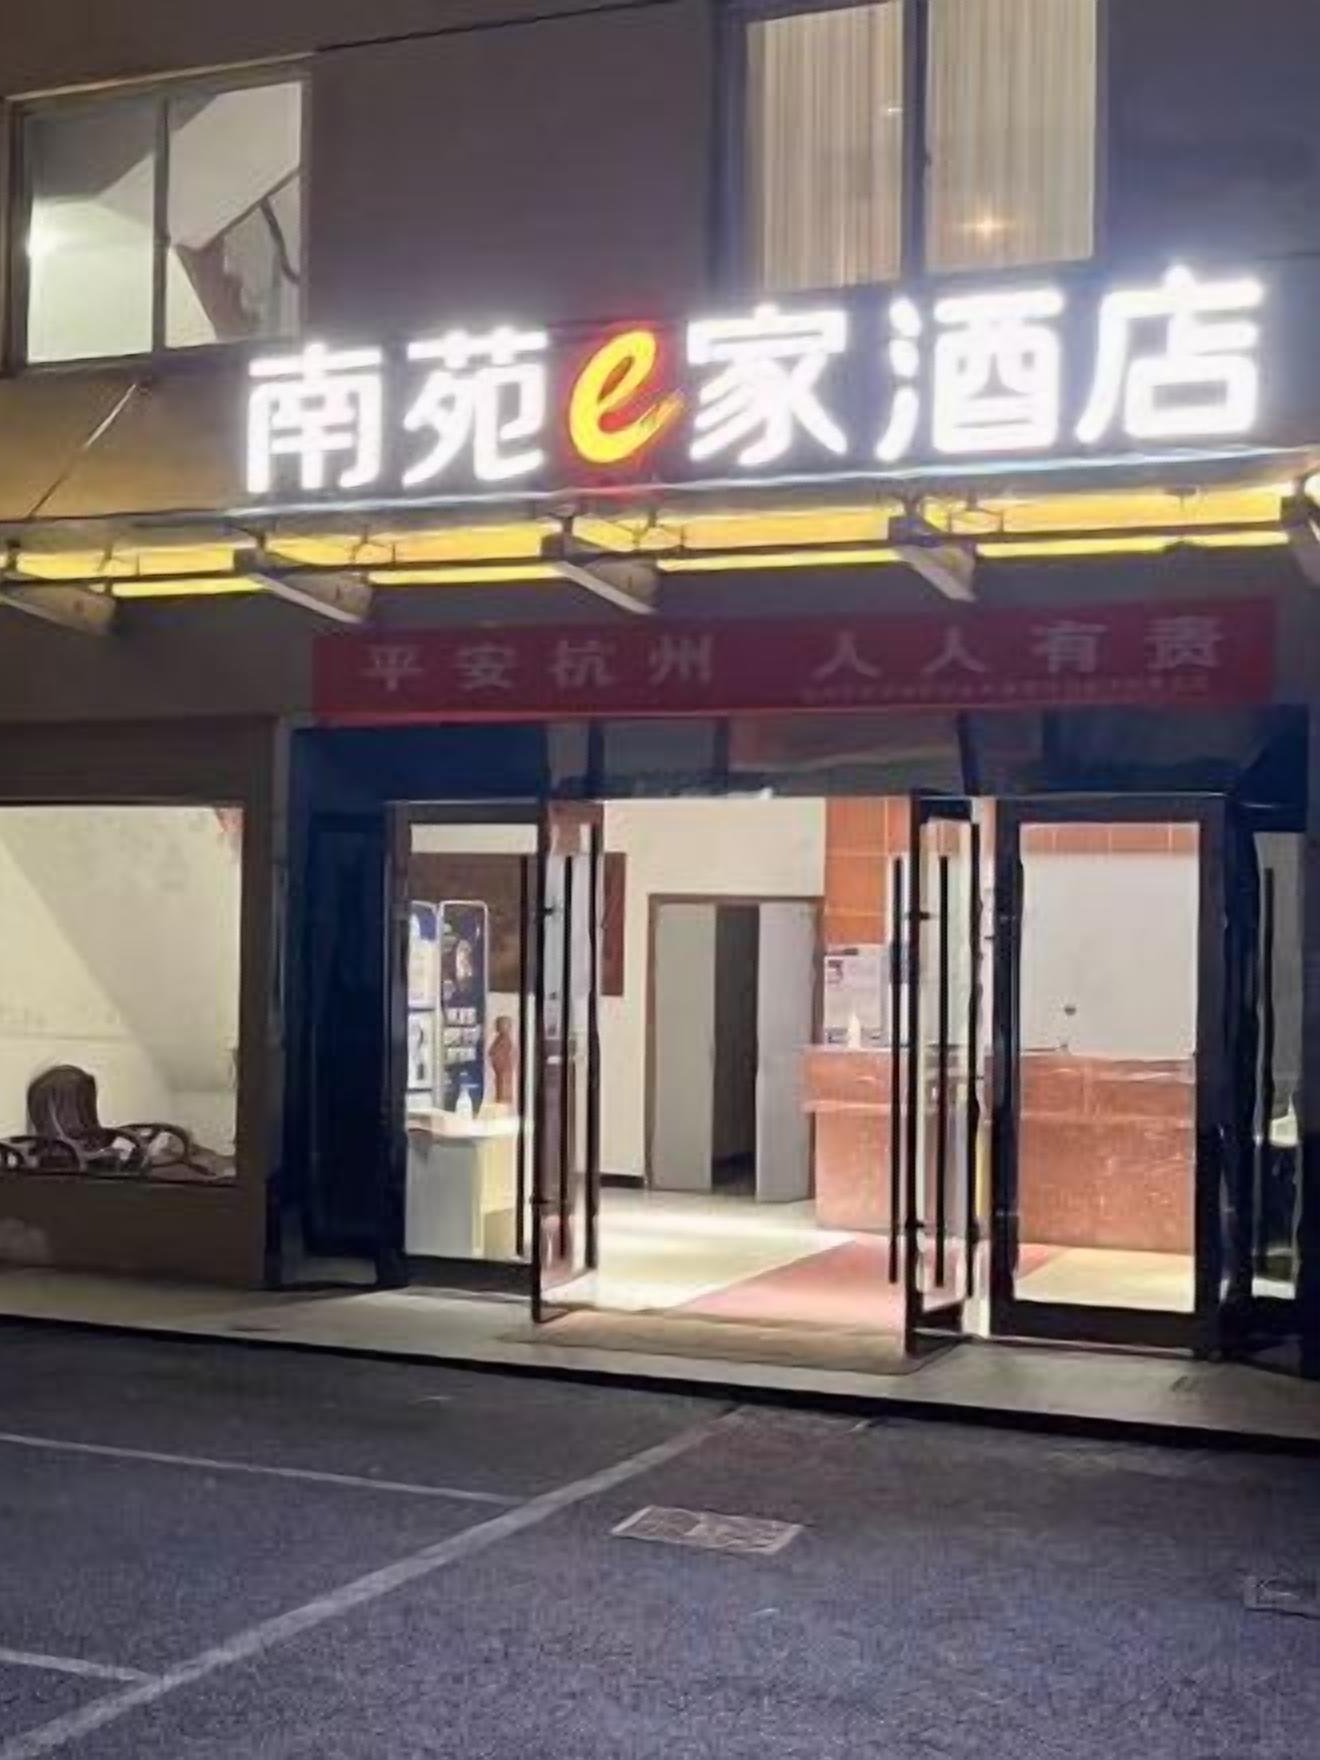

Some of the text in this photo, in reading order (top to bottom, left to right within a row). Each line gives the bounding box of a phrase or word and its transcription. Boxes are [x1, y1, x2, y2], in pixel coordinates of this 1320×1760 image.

[244, 265, 1267, 496] 南苑e家酒店
[362, 614, 1223, 692] 平安杭州 人人有责
